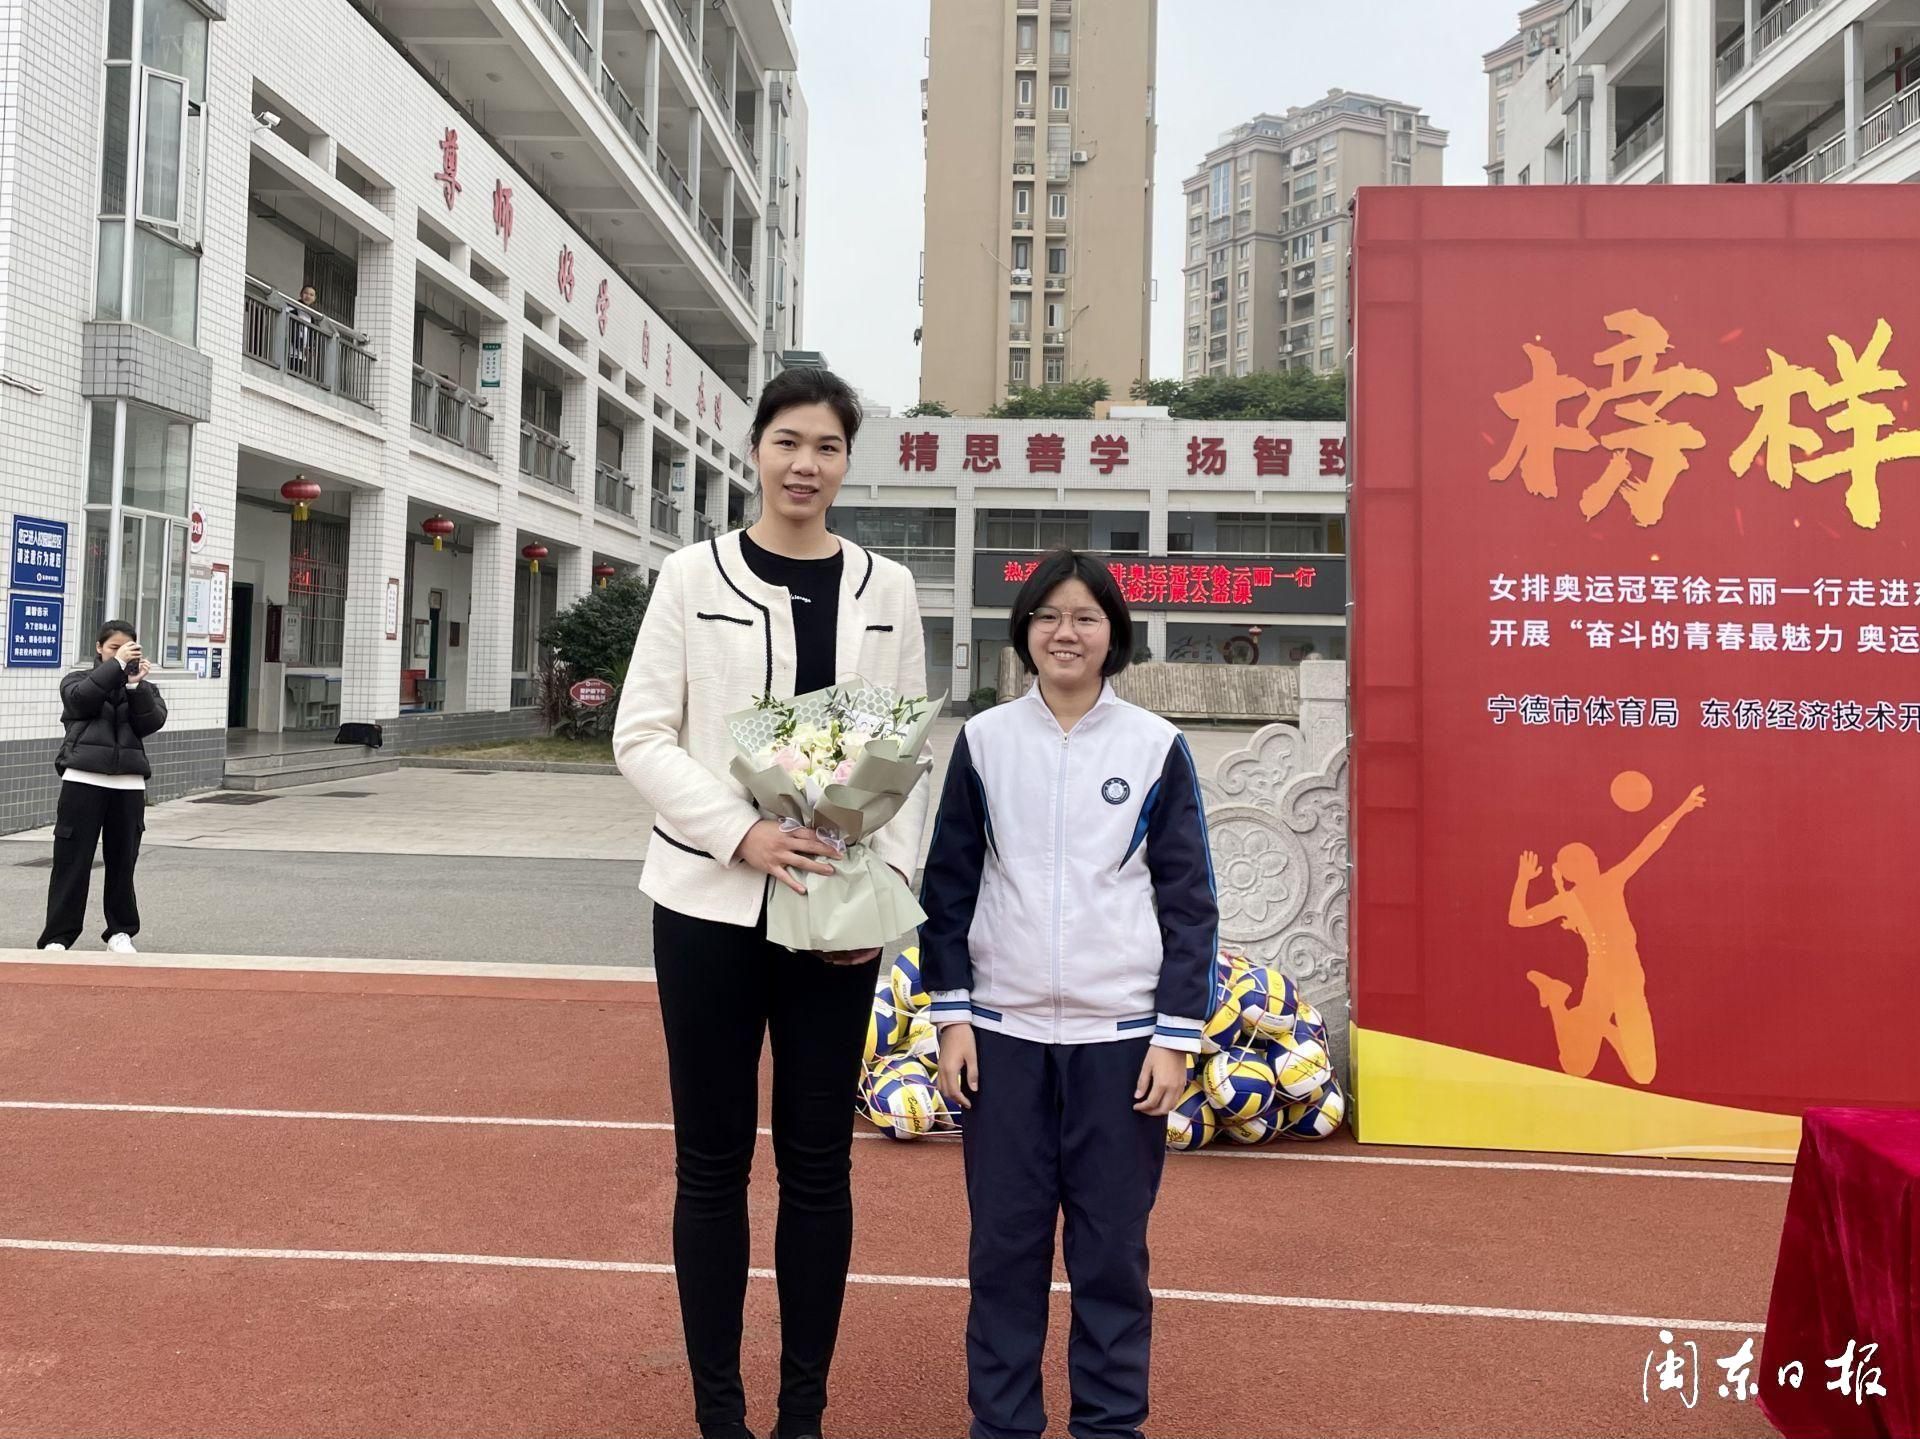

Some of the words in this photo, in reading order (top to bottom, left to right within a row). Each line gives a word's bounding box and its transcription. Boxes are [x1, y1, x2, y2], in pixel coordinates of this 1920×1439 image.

[1489, 308, 1920, 529] 榜样
[899, 432, 1129, 474] 精思善学
[1489, 573, 1920, 608] 女排奥运冠军徐云丽一行走进
[1488, 694, 1679, 727] 宁德市体育局
[1700, 697, 1920, 733] 东侨经济技术开
